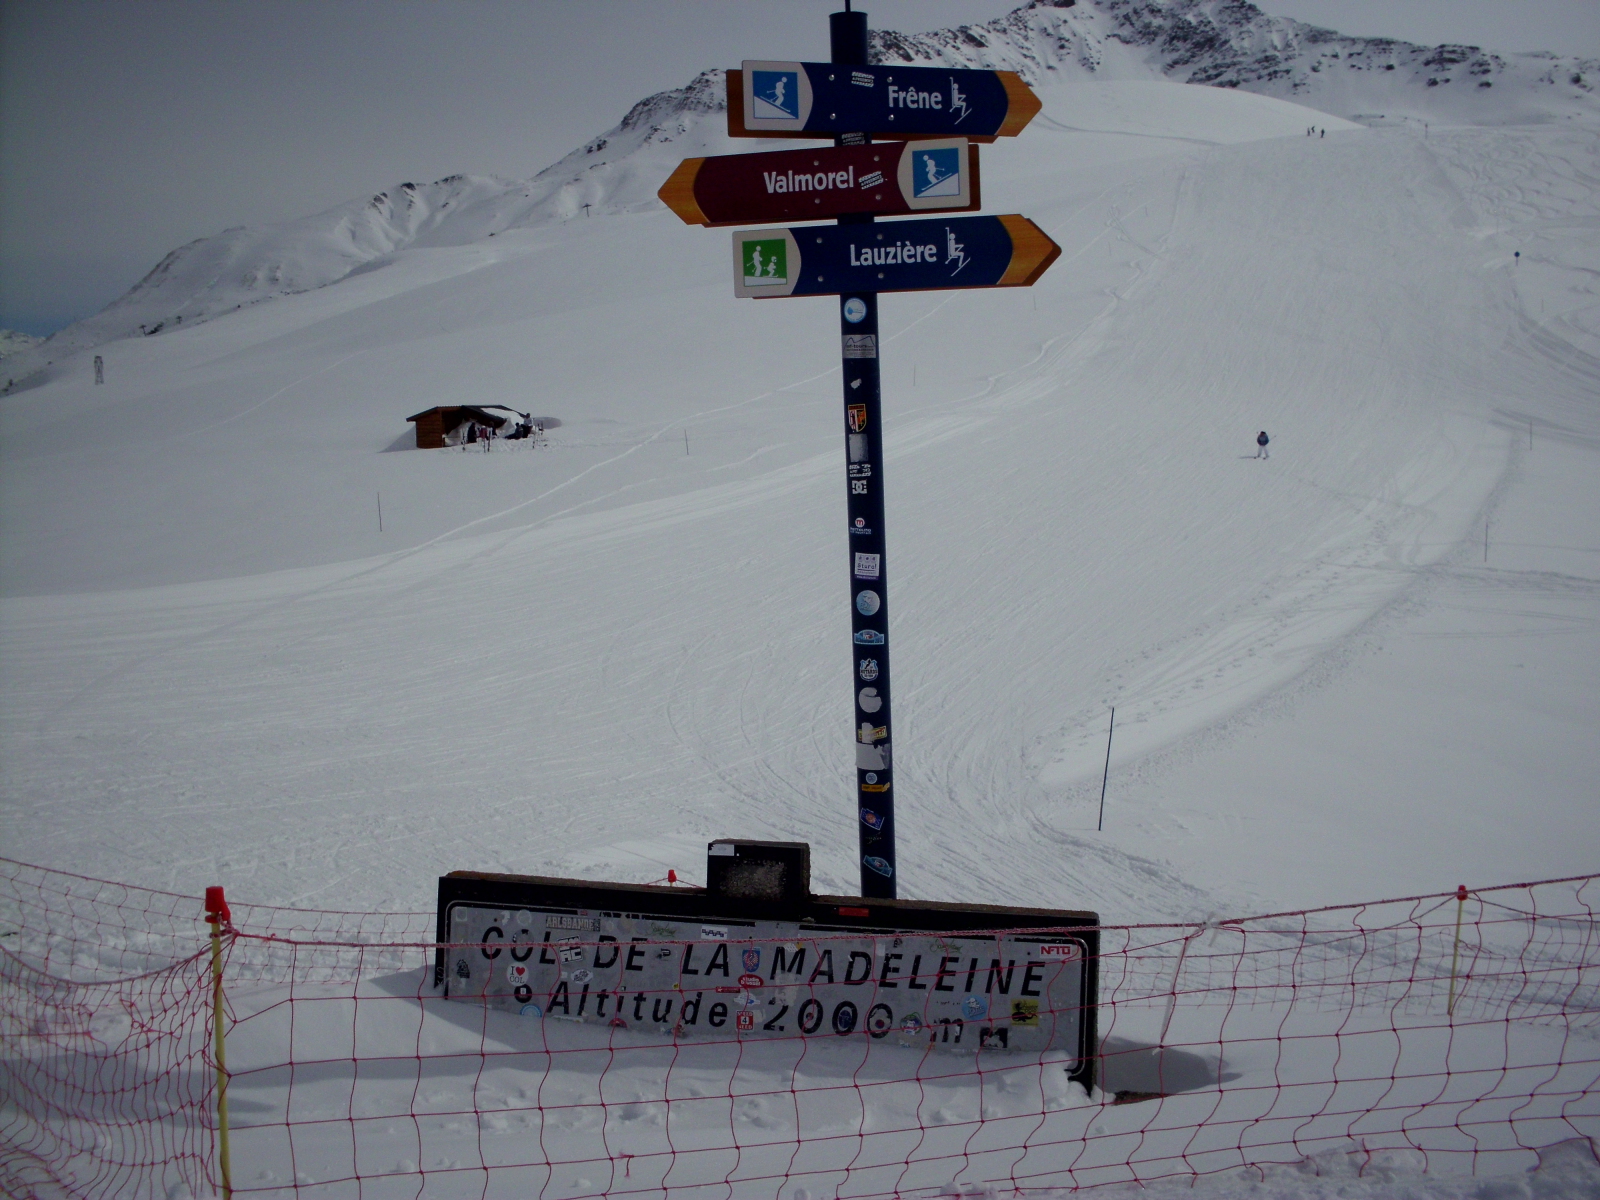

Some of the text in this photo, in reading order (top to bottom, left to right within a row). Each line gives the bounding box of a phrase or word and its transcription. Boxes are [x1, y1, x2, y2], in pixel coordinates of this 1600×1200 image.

[888, 85, 942, 110] Frêne
[763, 165, 854, 194] Valmorel
[850, 241, 937, 267] Lauzière
[481, 925, 557, 965] COL
[593, 934, 649, 971] DE
[681, 941, 730, 977] LA
[770, 945, 1046, 997] MADELEINE
[546, 980, 728, 1027] Altitude
[762, 997, 894, 1039] 2000
